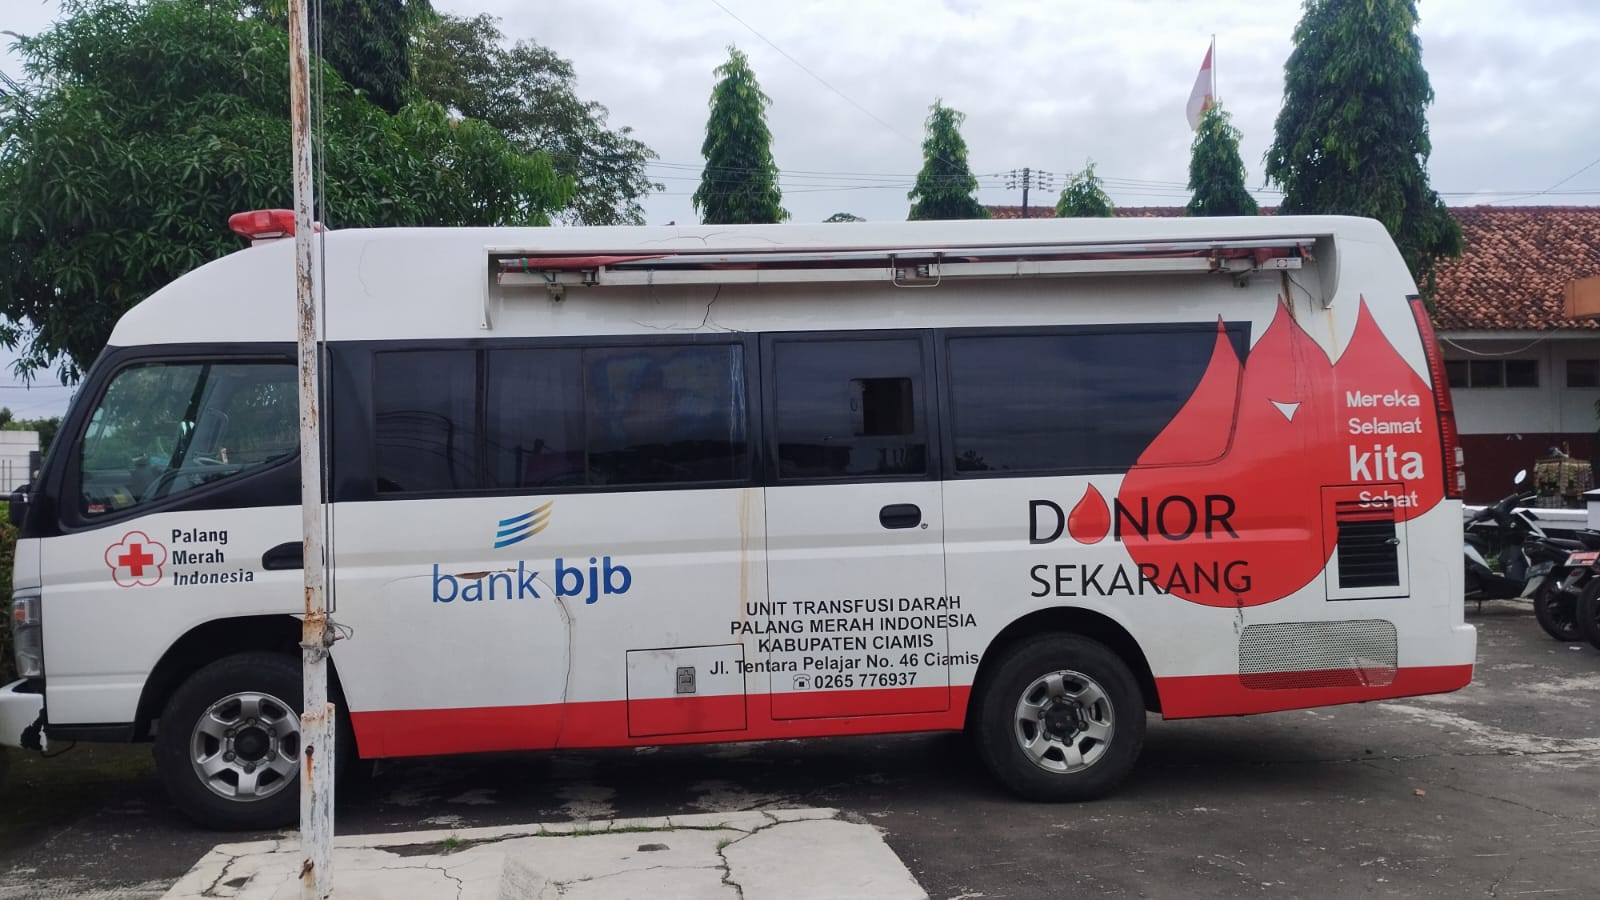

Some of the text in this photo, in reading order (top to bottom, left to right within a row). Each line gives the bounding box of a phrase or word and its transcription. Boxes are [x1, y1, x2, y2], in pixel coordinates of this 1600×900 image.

[1346, 389, 1420, 408] Mereka
[1349, 416, 1422, 435] Selamat
[1349, 443, 1424, 481] kita
[171, 528, 228, 545] Palang
[172, 549, 225, 565] Merah
[173, 569, 254, 586] Indonesia
[432, 556, 632, 604] bank bjb
[1030, 560, 1251, 598] SEKARANG
[746, 596, 961, 616] UNIT TRANSFUSI DARAH
[731, 613, 977, 635] PALANG MERAH INDONESIA
[758, 634, 934, 653] KABUPATEN CIAMIS
[709, 651, 979, 675] Jl. Tentara Pelajar No. 46 Ciamis
[814, 672, 917, 689] 0265 776937
